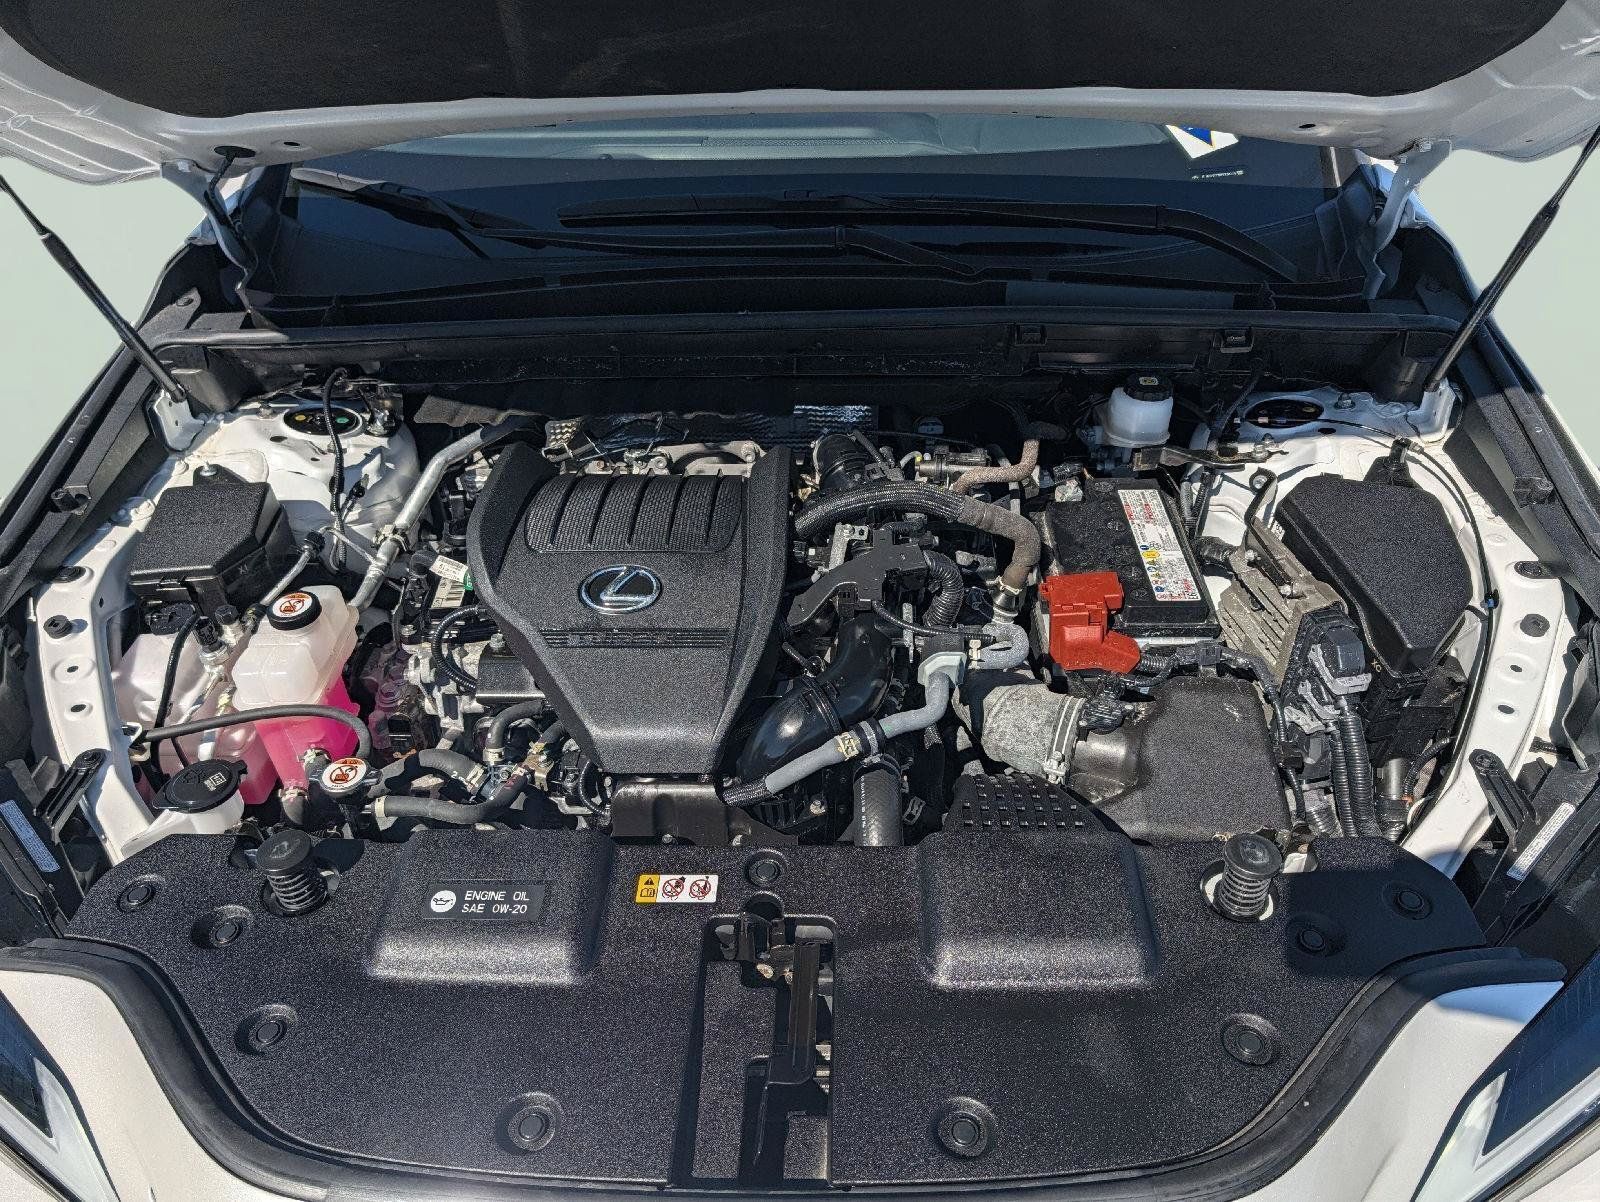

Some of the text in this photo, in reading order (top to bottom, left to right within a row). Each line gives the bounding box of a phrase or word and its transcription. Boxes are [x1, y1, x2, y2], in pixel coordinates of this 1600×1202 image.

[464, 890, 530, 901] ENGINE OIL
[461, 903, 528, 914] SAE 0W-20
